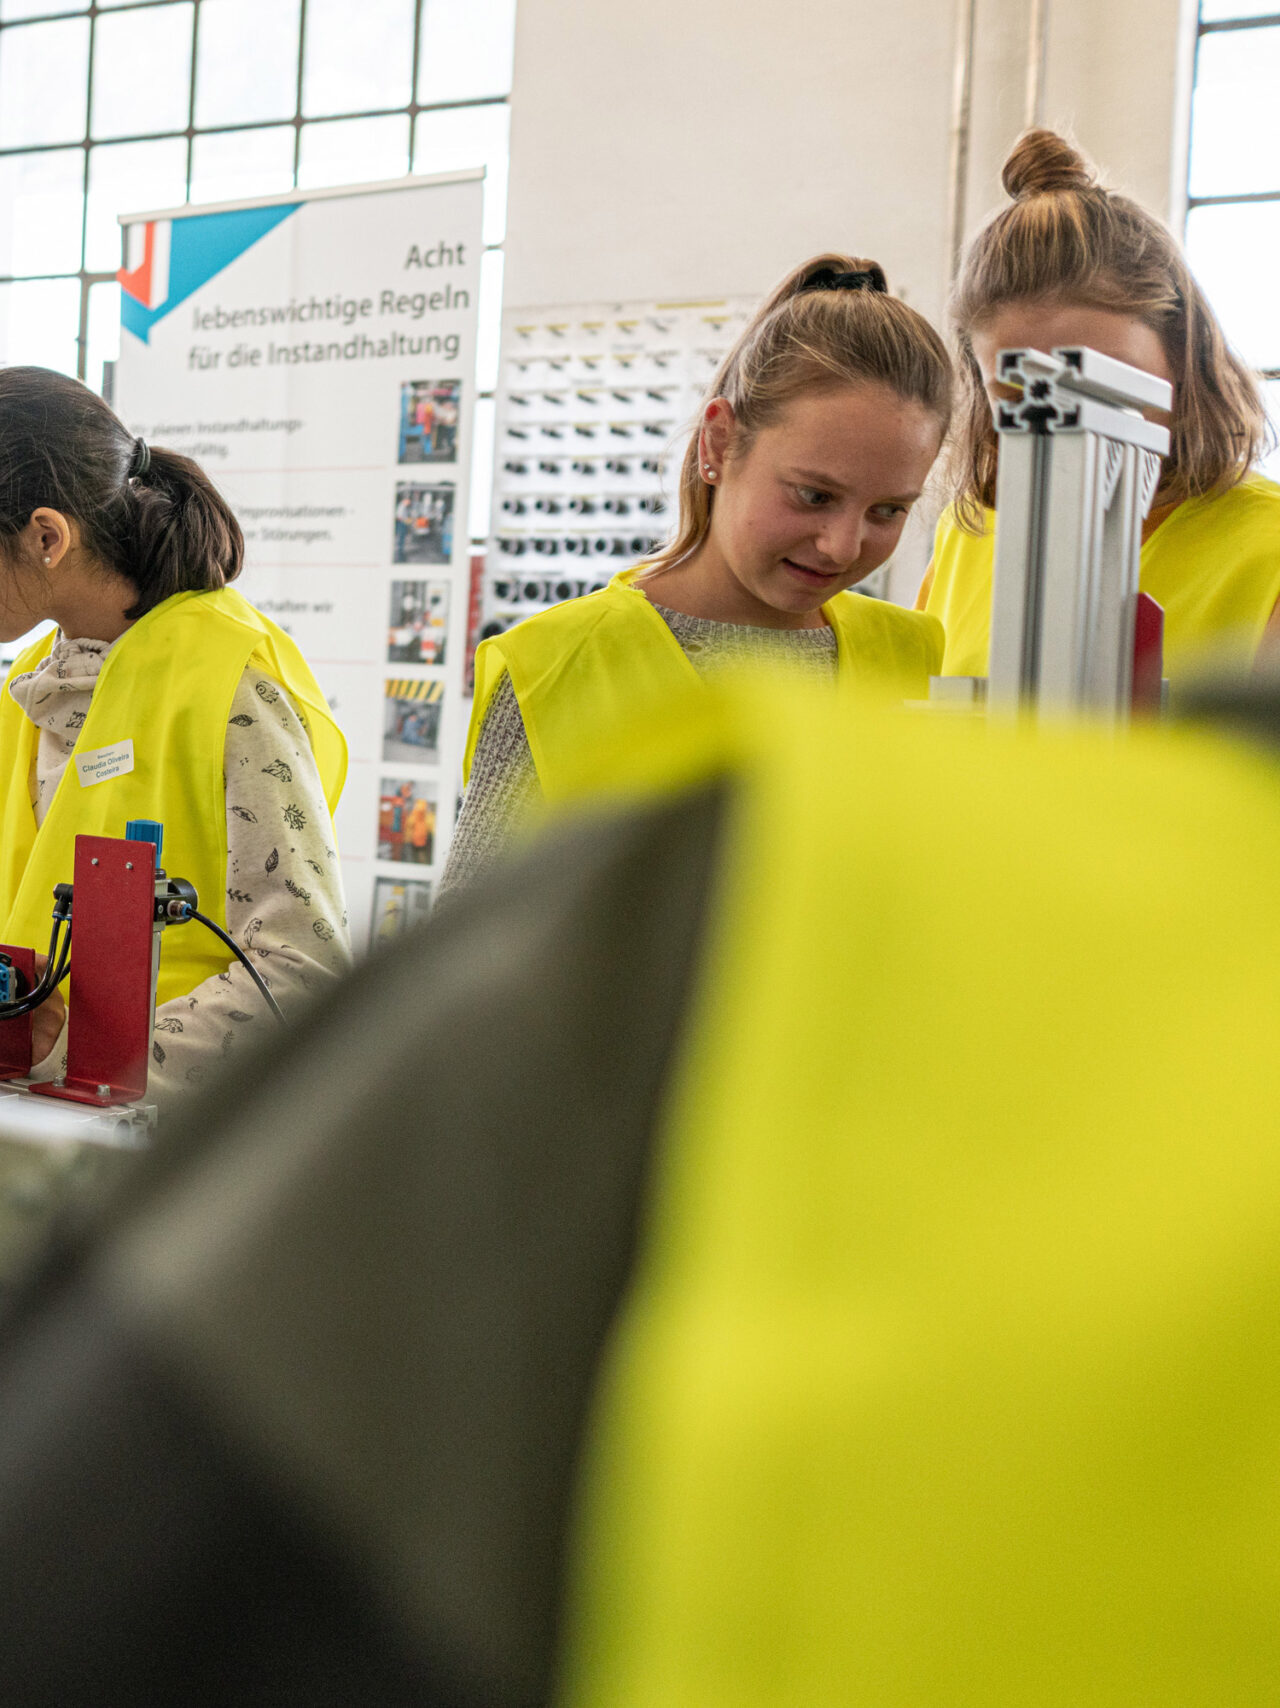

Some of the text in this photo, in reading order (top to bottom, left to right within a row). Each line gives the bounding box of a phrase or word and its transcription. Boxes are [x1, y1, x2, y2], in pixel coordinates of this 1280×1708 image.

[405, 240, 466, 270] Acht
[192, 283, 470, 331] lebenswichtige Regeln
[188, 331, 461, 371] für die Instandhaltung
[82, 760, 107, 773] Claudia
[107, 753, 130, 765] Oliveira
[95, 766, 120, 778] Costeira
